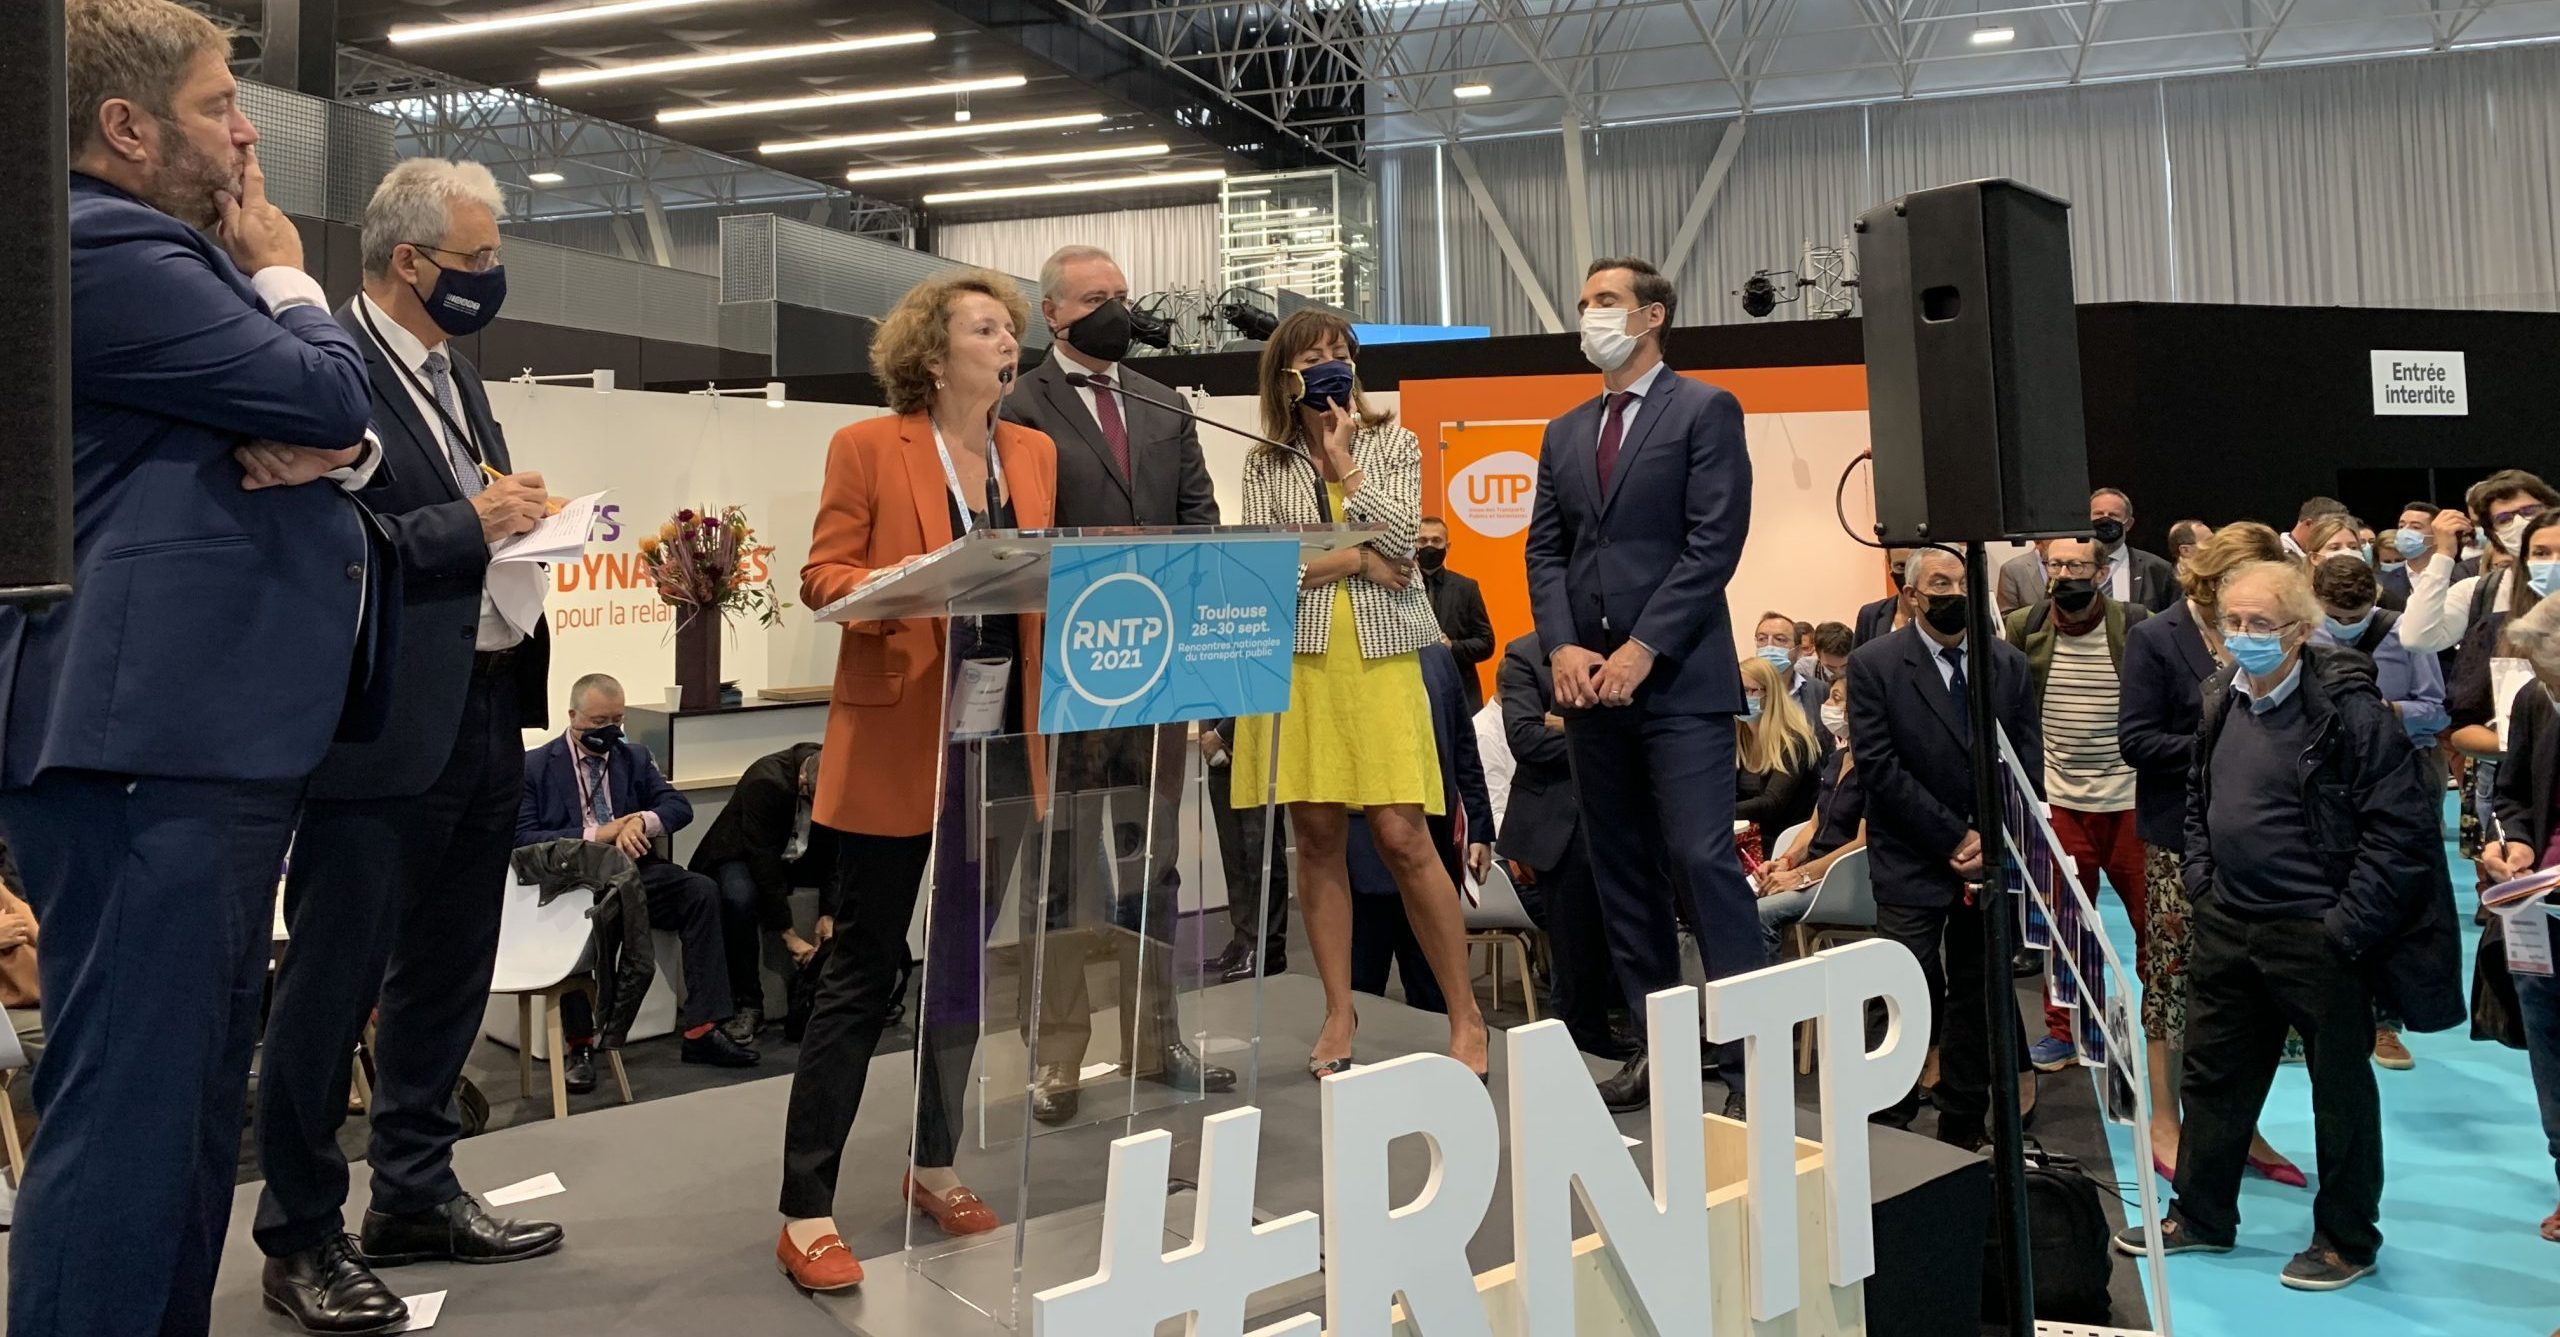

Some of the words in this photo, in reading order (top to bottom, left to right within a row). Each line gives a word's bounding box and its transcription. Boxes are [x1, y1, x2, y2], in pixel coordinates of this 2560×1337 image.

[2392, 362, 2446, 382] Entrée
[2385, 384, 2456, 404] interdite
[1467, 473, 1532, 505] UTP
[556, 606, 603, 635] pour
[609, 600, 630, 626] la
[1197, 603, 1267, 620] Toulouse
[1073, 616, 1163, 650] RNTP
[1238, 620, 1270, 636] sept.
[1178, 641, 1231, 653] Rencontres
[1232, 637, 1281, 650] nationales
[1184, 651, 1199, 662] du
[1199, 648, 1244, 661] transport
[1244, 646, 1273, 660] public
[1090, 648, 1143, 671] 2021
